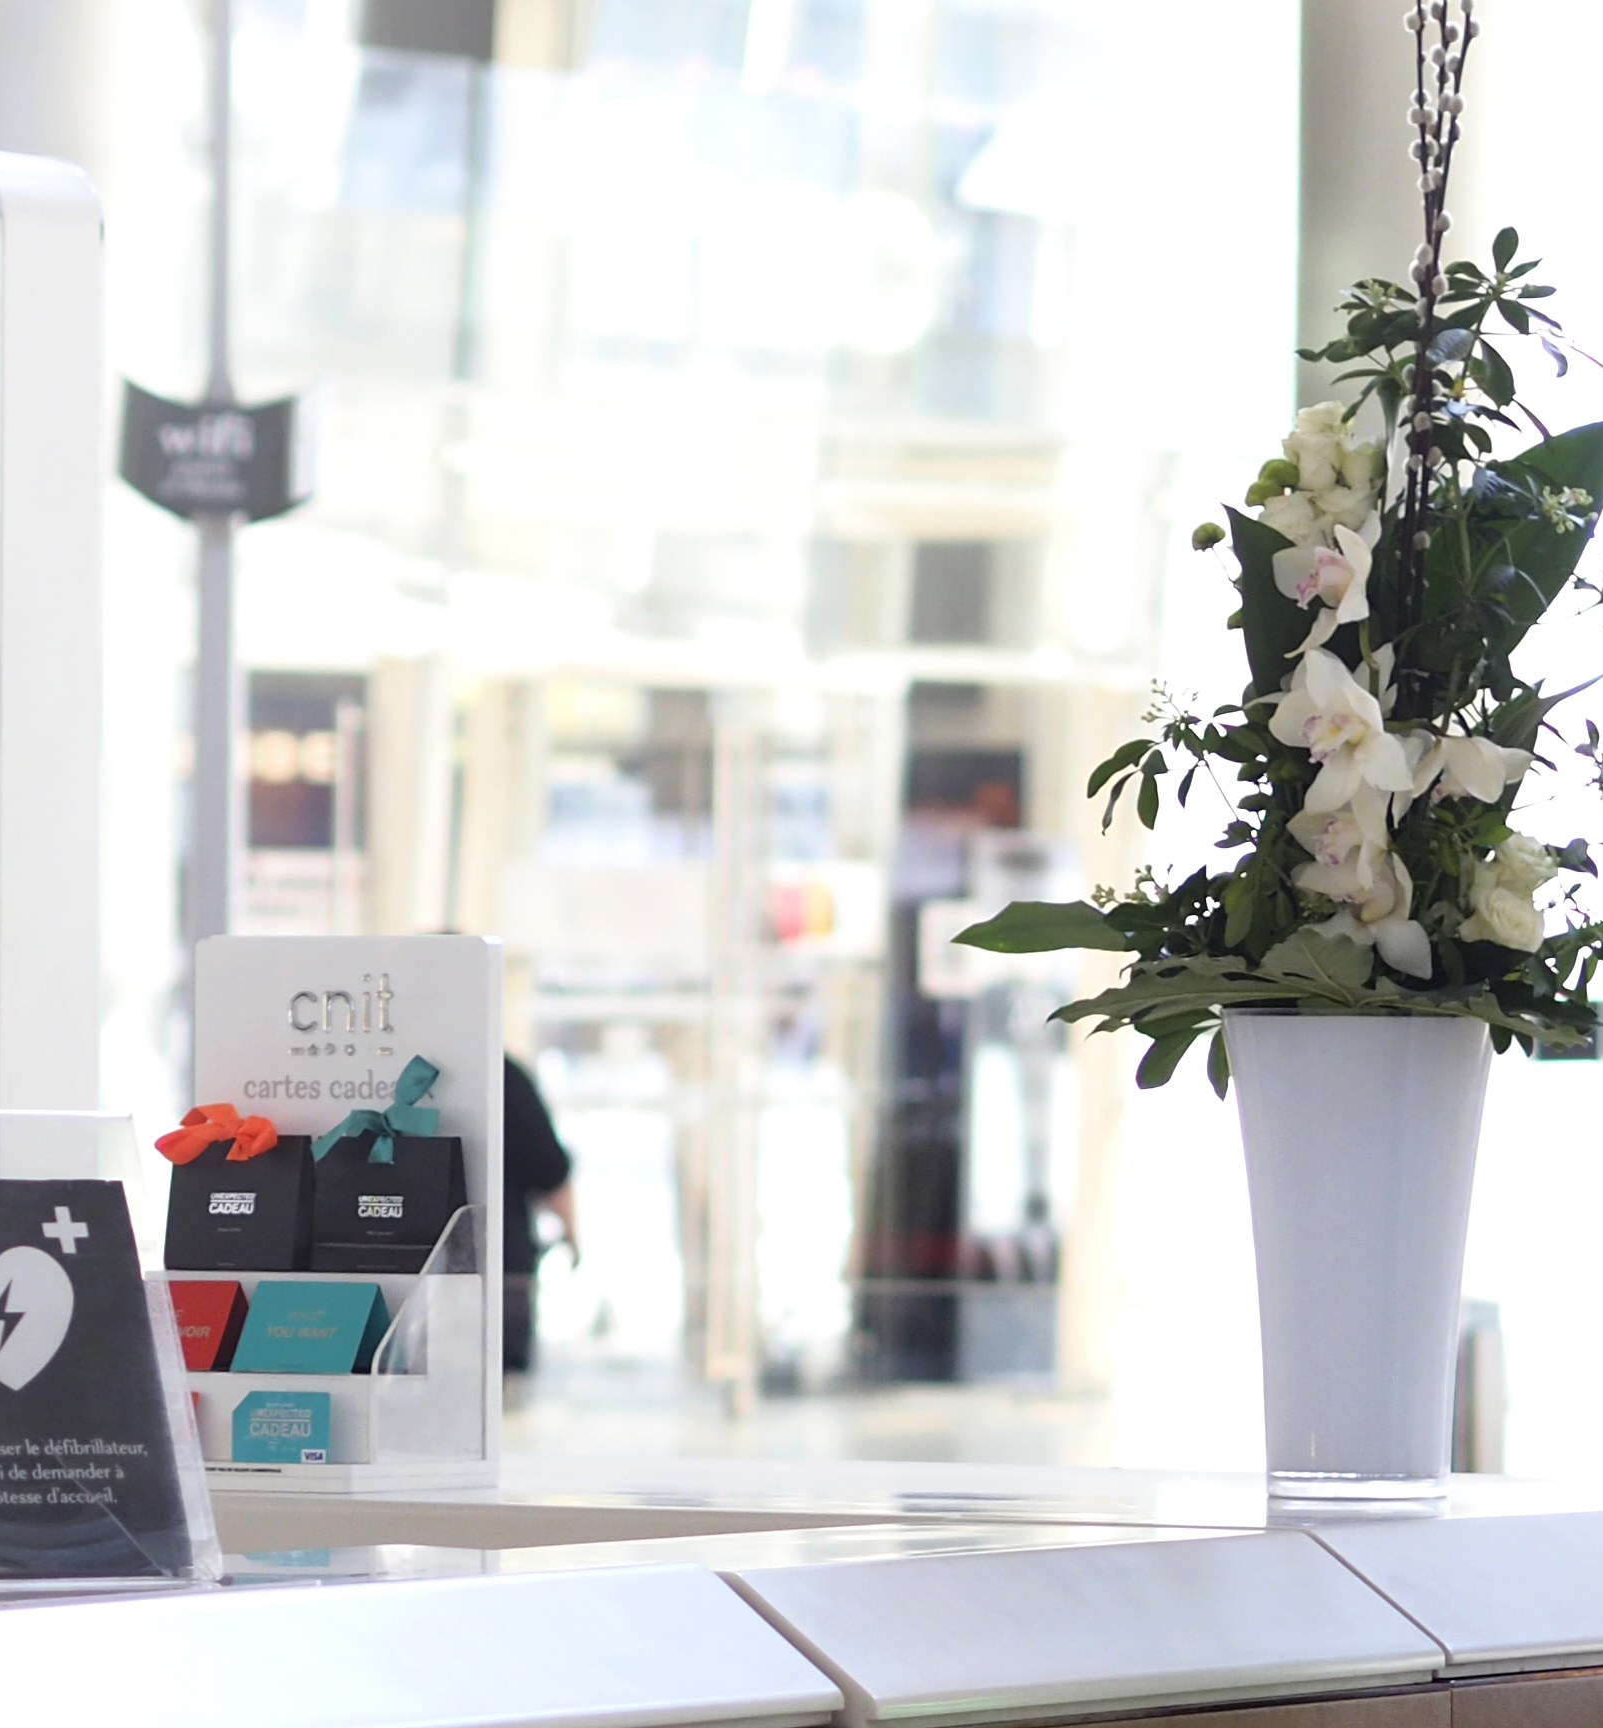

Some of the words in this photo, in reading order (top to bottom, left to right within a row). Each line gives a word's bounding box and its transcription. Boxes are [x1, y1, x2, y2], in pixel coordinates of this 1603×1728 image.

[287, 973, 395, 1034] cnit
[243, 1073, 322, 1100] cartes
[208, 1202, 255, 1215] CADEAU
[357, 1205, 404, 1218] CADEAU
[267, 1325, 295, 1338] YOU
[298, 1326, 338, 1338] WANT
[250, 1408, 313, 1419] UNEXPECTED
[249, 1422, 312, 1438] CADEAU
[25, 1439, 40, 1456] le
[44, 1438, 149, 1459] défibrillateur,
[303, 1451, 324, 1461] VISA
[7, 1463, 28, 1480] de
[32, 1463, 111, 1481] demander
[114, 1464, 125, 1480] à
[46, 1486, 119, 1505] d'accueil.
